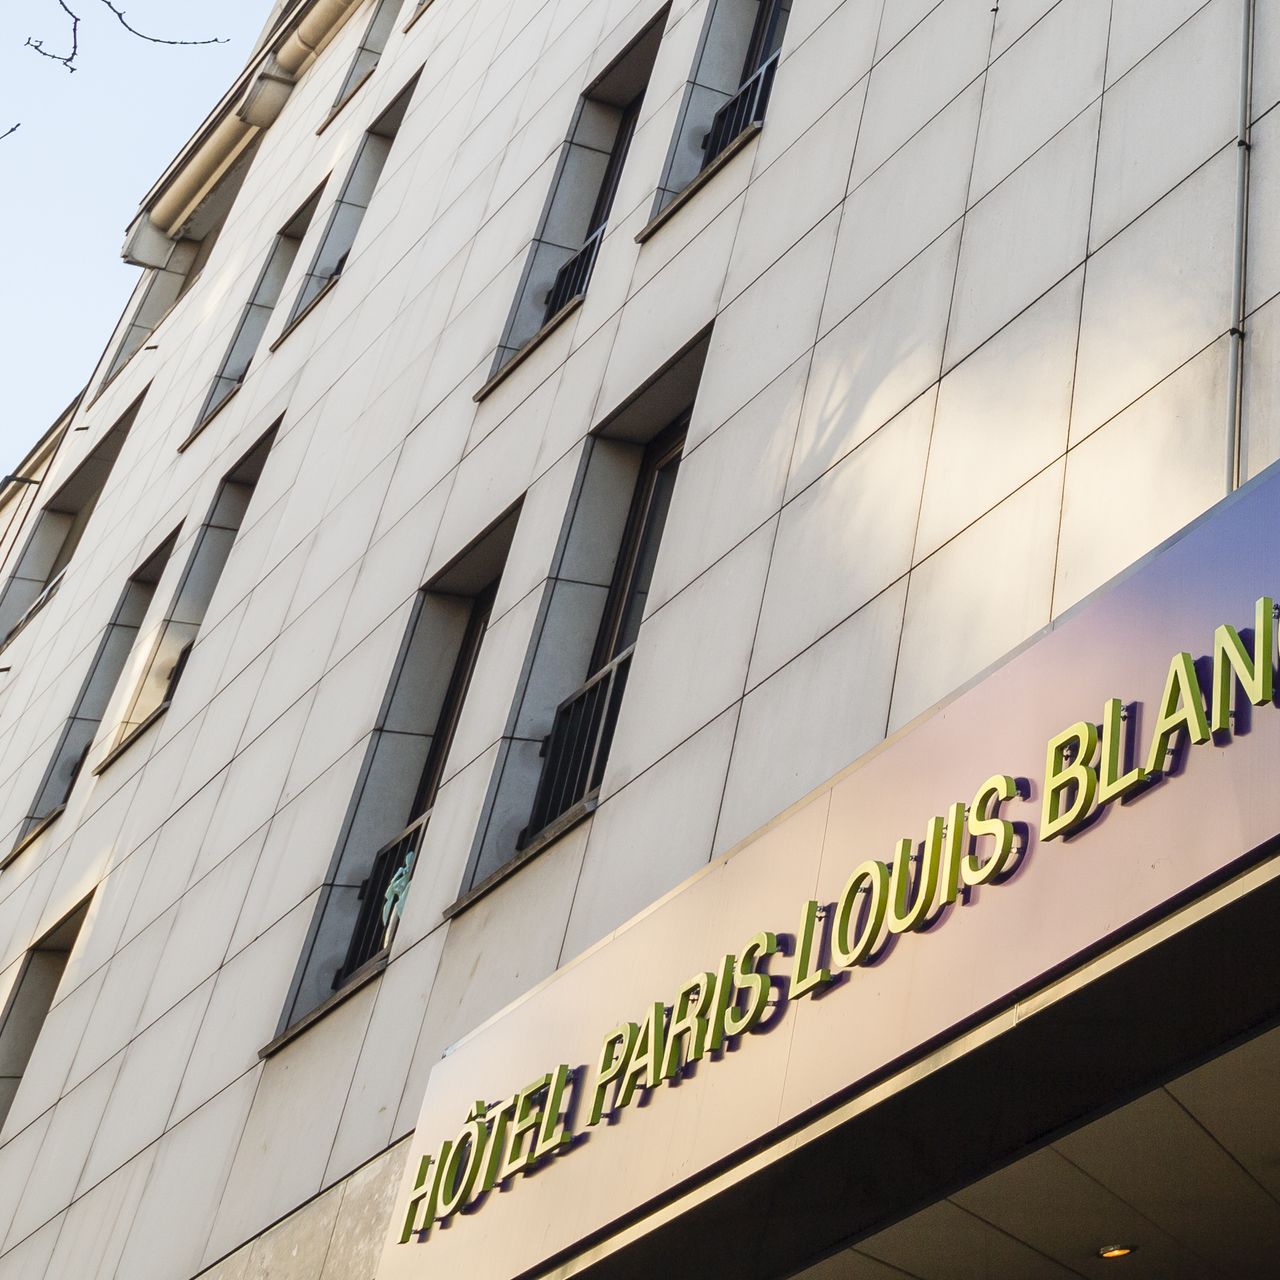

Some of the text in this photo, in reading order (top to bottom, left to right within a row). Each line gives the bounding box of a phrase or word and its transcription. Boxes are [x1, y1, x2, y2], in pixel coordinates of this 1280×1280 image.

[397, 1062, 574, 1244] HÔTEL
[587, 930, 779, 1127] PARIS
[788, 773, 1017, 1000] LOUIS
